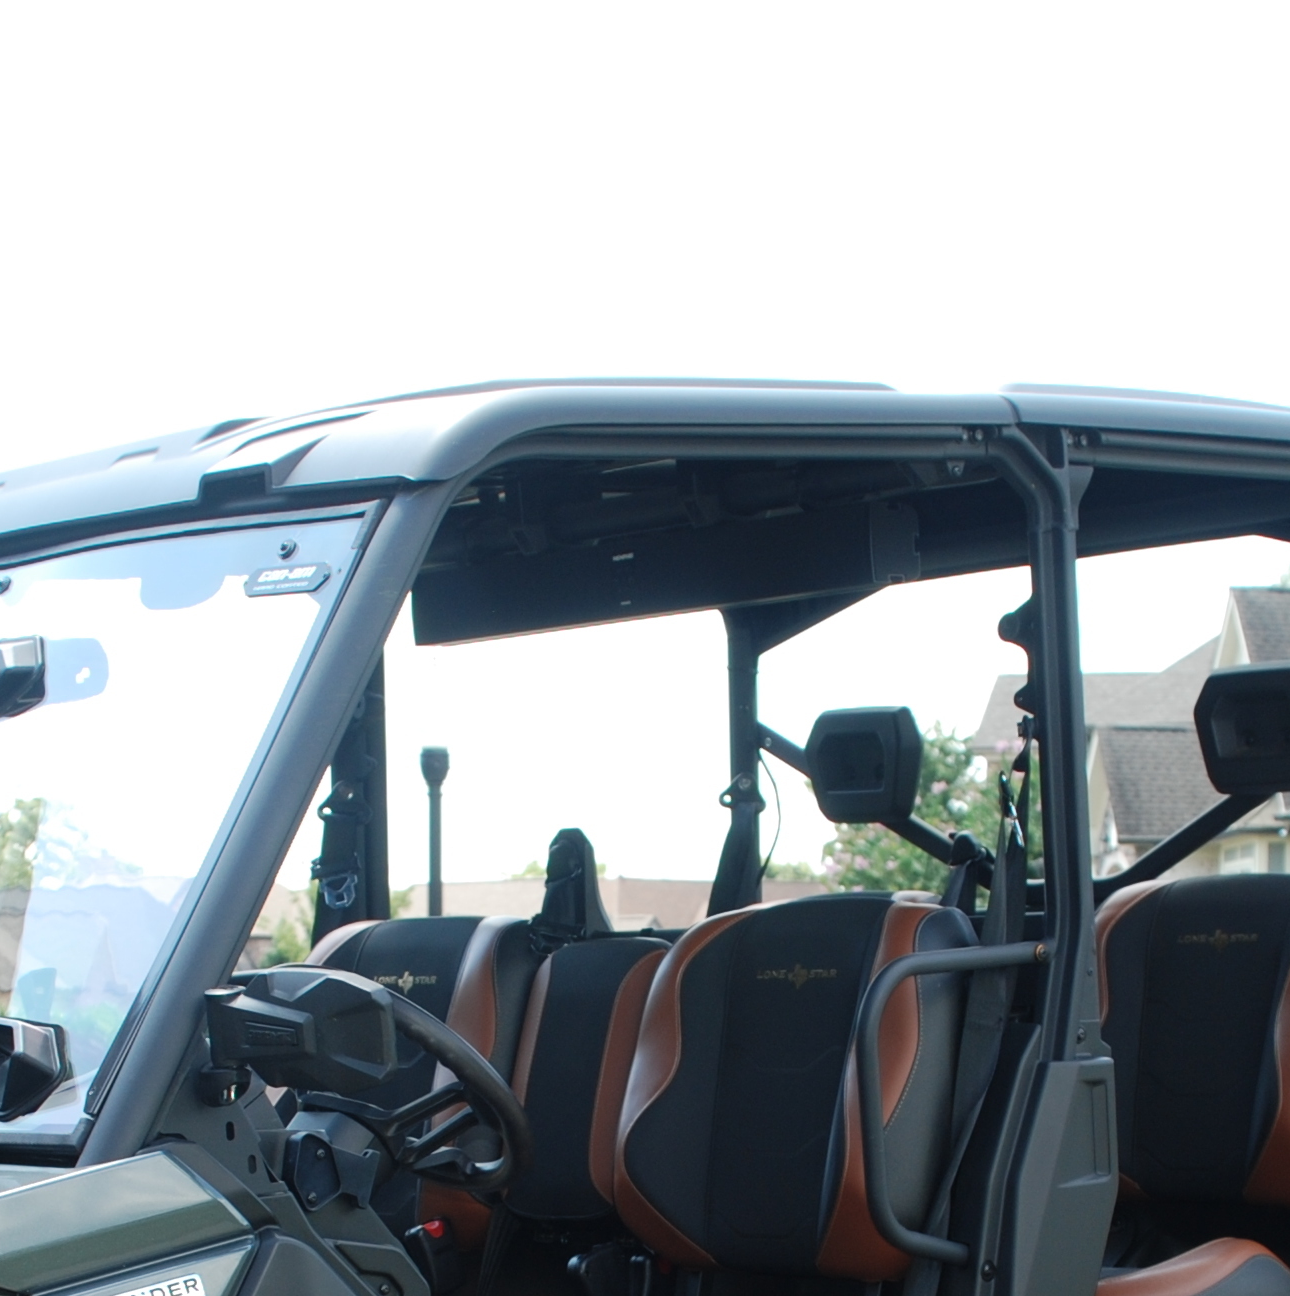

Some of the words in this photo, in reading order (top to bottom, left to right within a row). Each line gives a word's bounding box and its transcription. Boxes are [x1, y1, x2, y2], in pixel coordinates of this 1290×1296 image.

[756, 969, 788, 980] LONE
[809, 968, 837, 979] STAR
[414, 975, 437, 985] STAR
